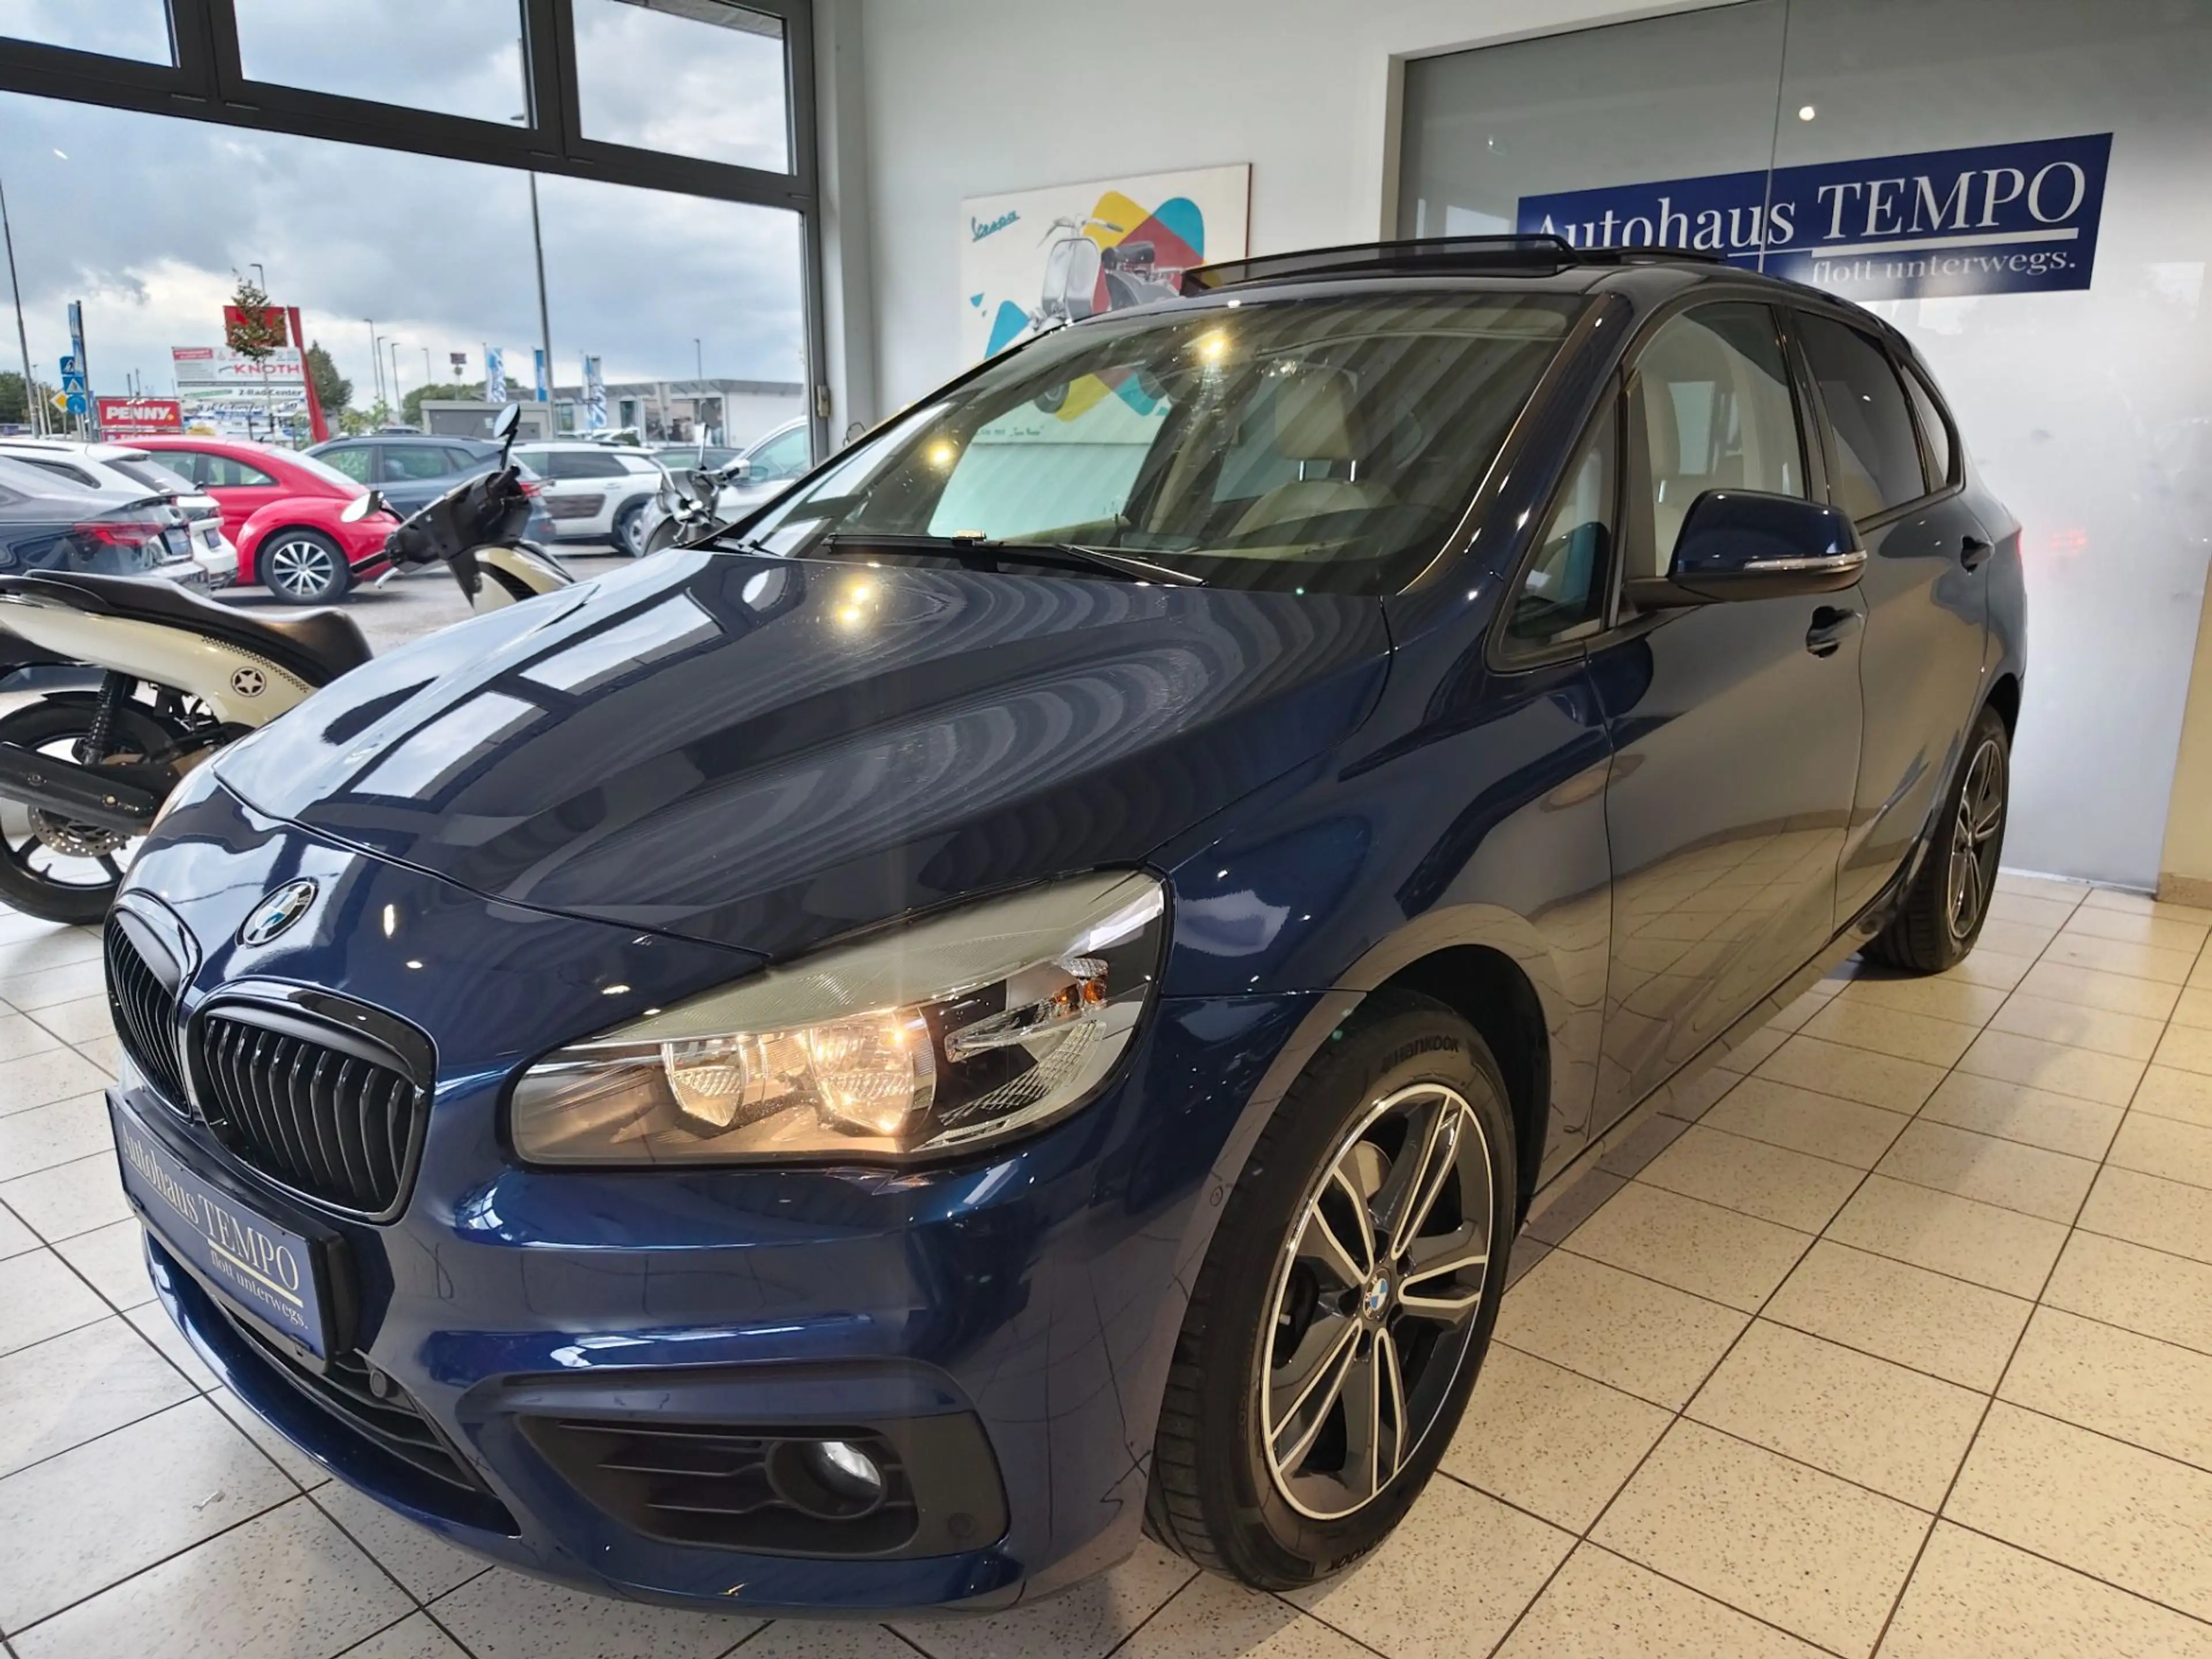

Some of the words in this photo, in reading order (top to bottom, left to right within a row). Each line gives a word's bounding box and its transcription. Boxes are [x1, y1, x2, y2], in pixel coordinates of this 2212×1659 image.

[1535, 197, 1795, 250] Autohaus
[1817, 161, 2085, 240] TEMPO
[971, 210, 1021, 243] Vespa
[1812, 260, 1873, 284] flott
[1886, 251, 2076, 280] unterwegs.
[234, 364, 300, 374] KNOTH
[105, 406, 171, 421] PENNY
[122, 1123, 199, 1224] Autohaus
[198, 1194, 300, 1292] TEMPO
[211, 1250, 234, 1278] flott
[236, 1271, 309, 1330] unterwegs.
